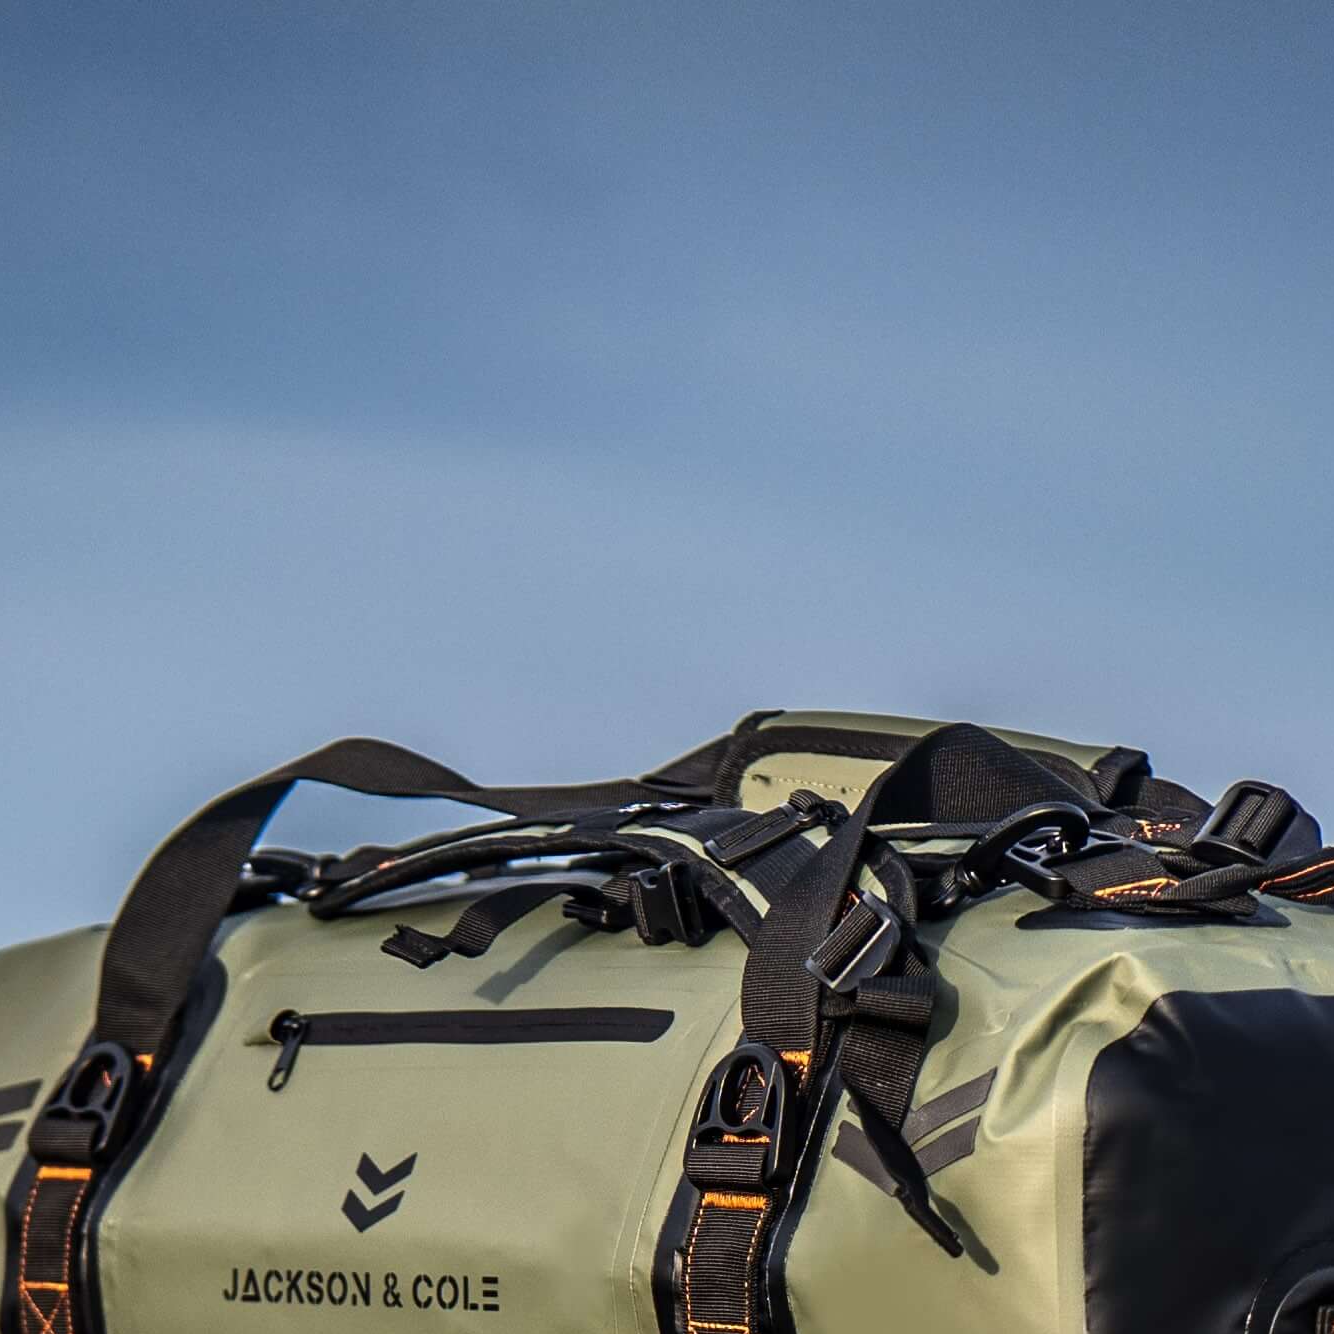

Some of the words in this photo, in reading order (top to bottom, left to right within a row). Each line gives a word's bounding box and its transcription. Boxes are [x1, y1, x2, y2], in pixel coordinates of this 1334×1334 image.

[223, 1267, 371, 1307] JACKSON
[382, 1271, 403, 1308] &
[411, 1274, 500, 1312] COLE
